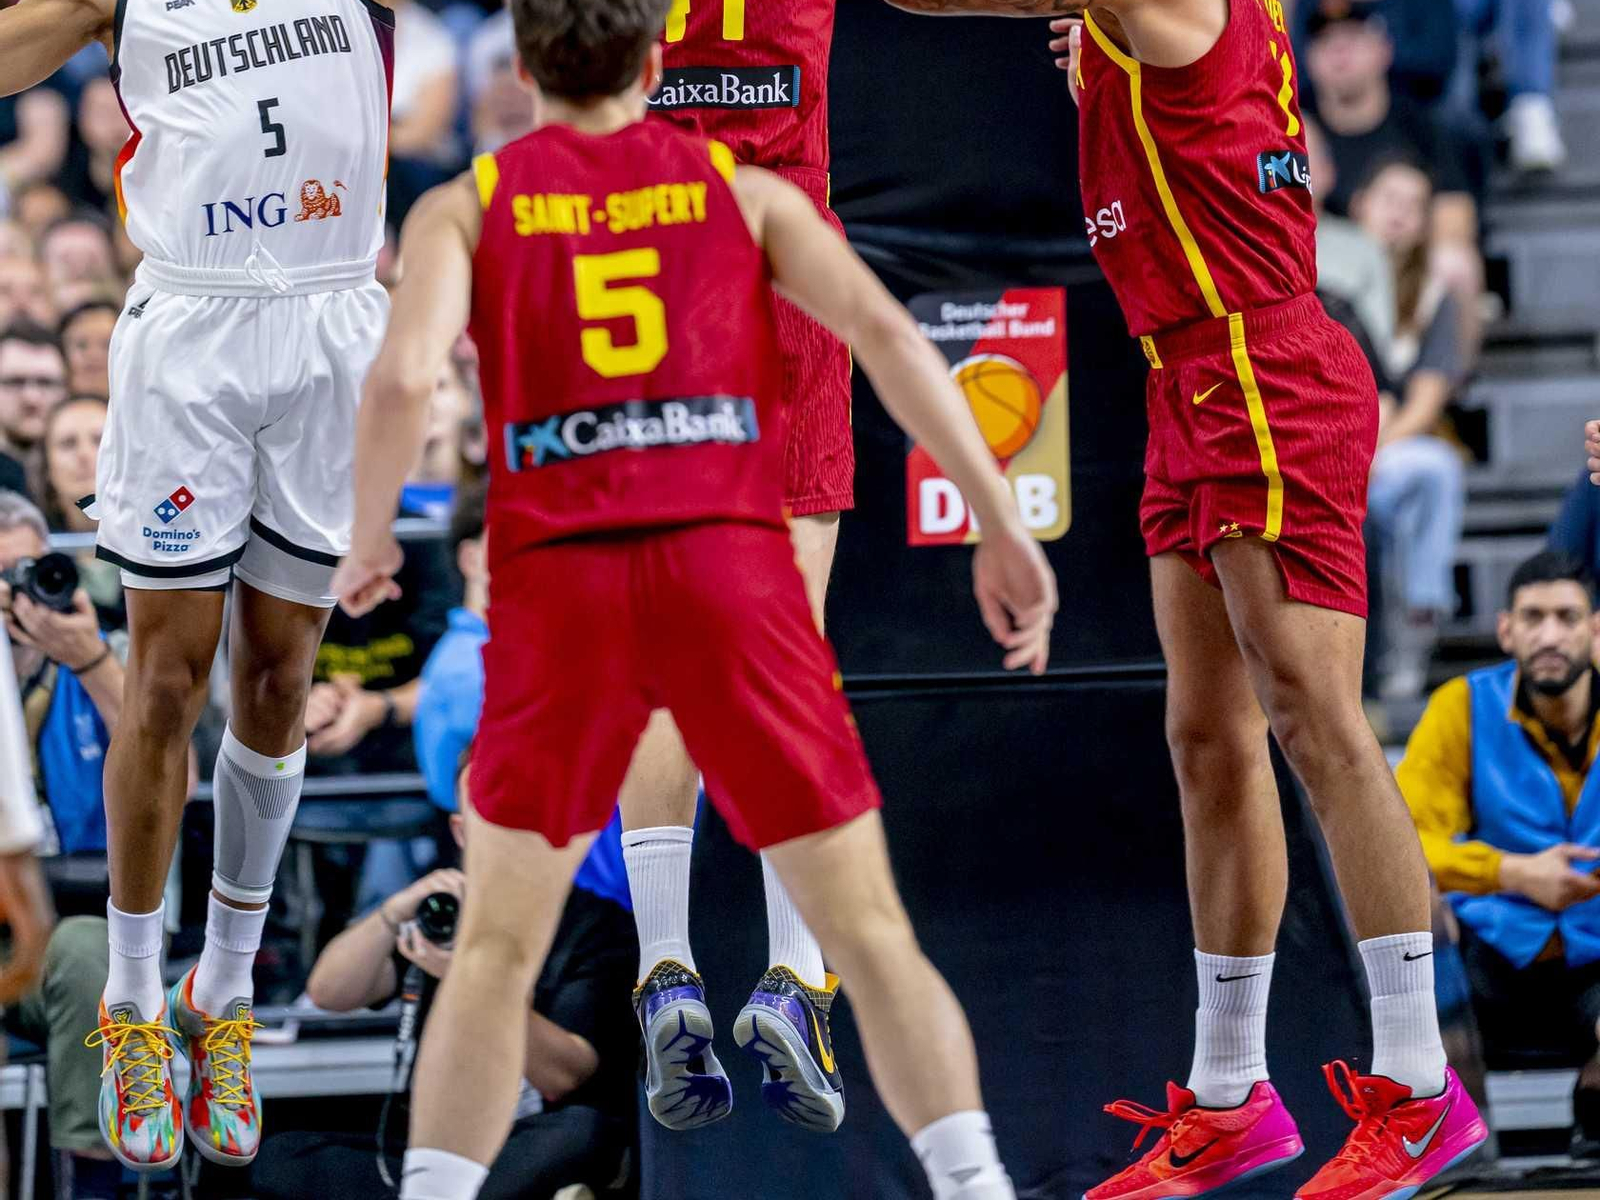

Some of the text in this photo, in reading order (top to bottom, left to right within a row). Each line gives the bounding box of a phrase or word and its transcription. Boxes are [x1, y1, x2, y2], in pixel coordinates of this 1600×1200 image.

[164, 14, 352, 95] DEUTSCHLAND
[645, 72, 791, 106] aixaBank
[256, 97, 287, 158] 5
[201, 192, 288, 237] ING
[572, 247, 668, 379] 5
[941, 302, 1029, 321] Deutscher
[1008, 317, 1056, 338] Bund
[561, 401, 748, 455] CaixaBank
[919, 473, 1060, 535] DB
[142, 525, 201, 540] Domino's
[152, 540, 189, 552] Pizza
